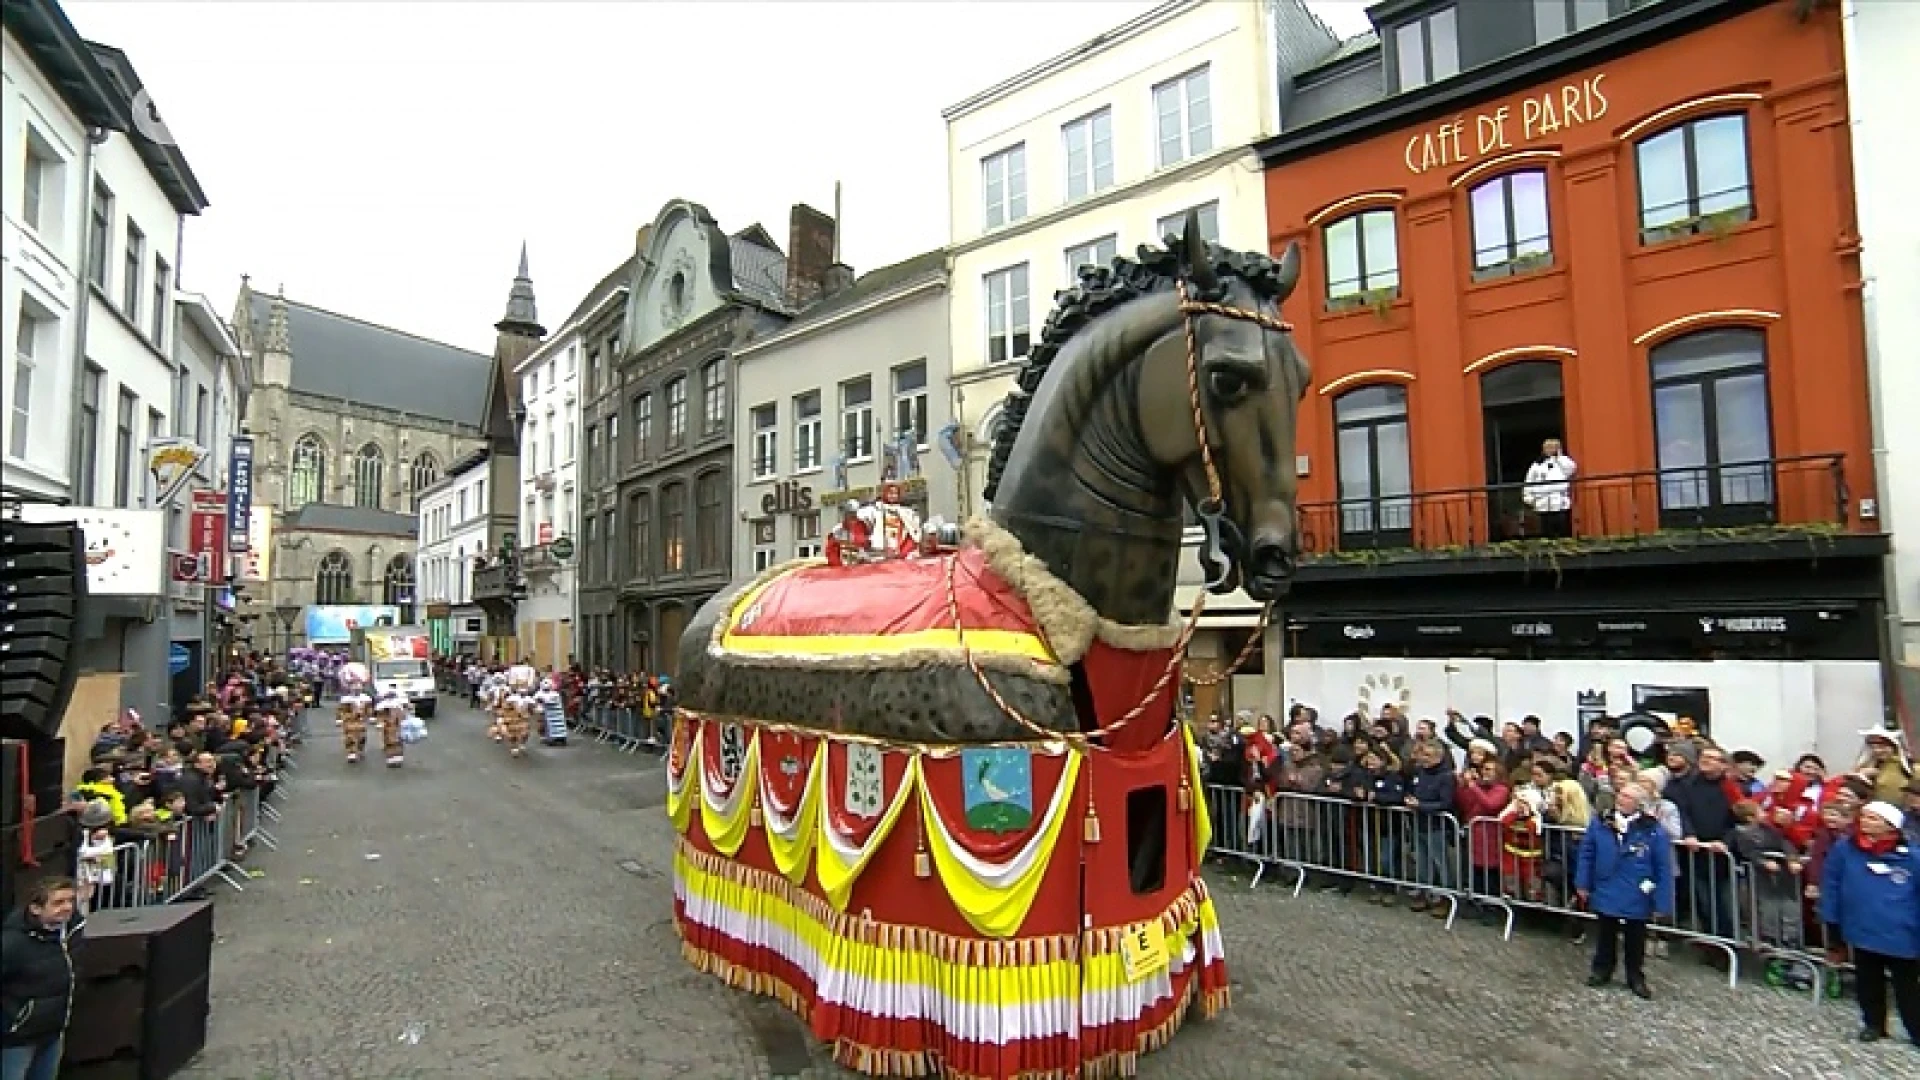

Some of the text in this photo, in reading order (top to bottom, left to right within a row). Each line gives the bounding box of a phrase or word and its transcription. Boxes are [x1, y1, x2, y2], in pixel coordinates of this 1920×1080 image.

[1476, 105, 1513, 154] DE
[1522, 73, 1608, 140] PARIS
[761, 480, 812, 514] ellis
